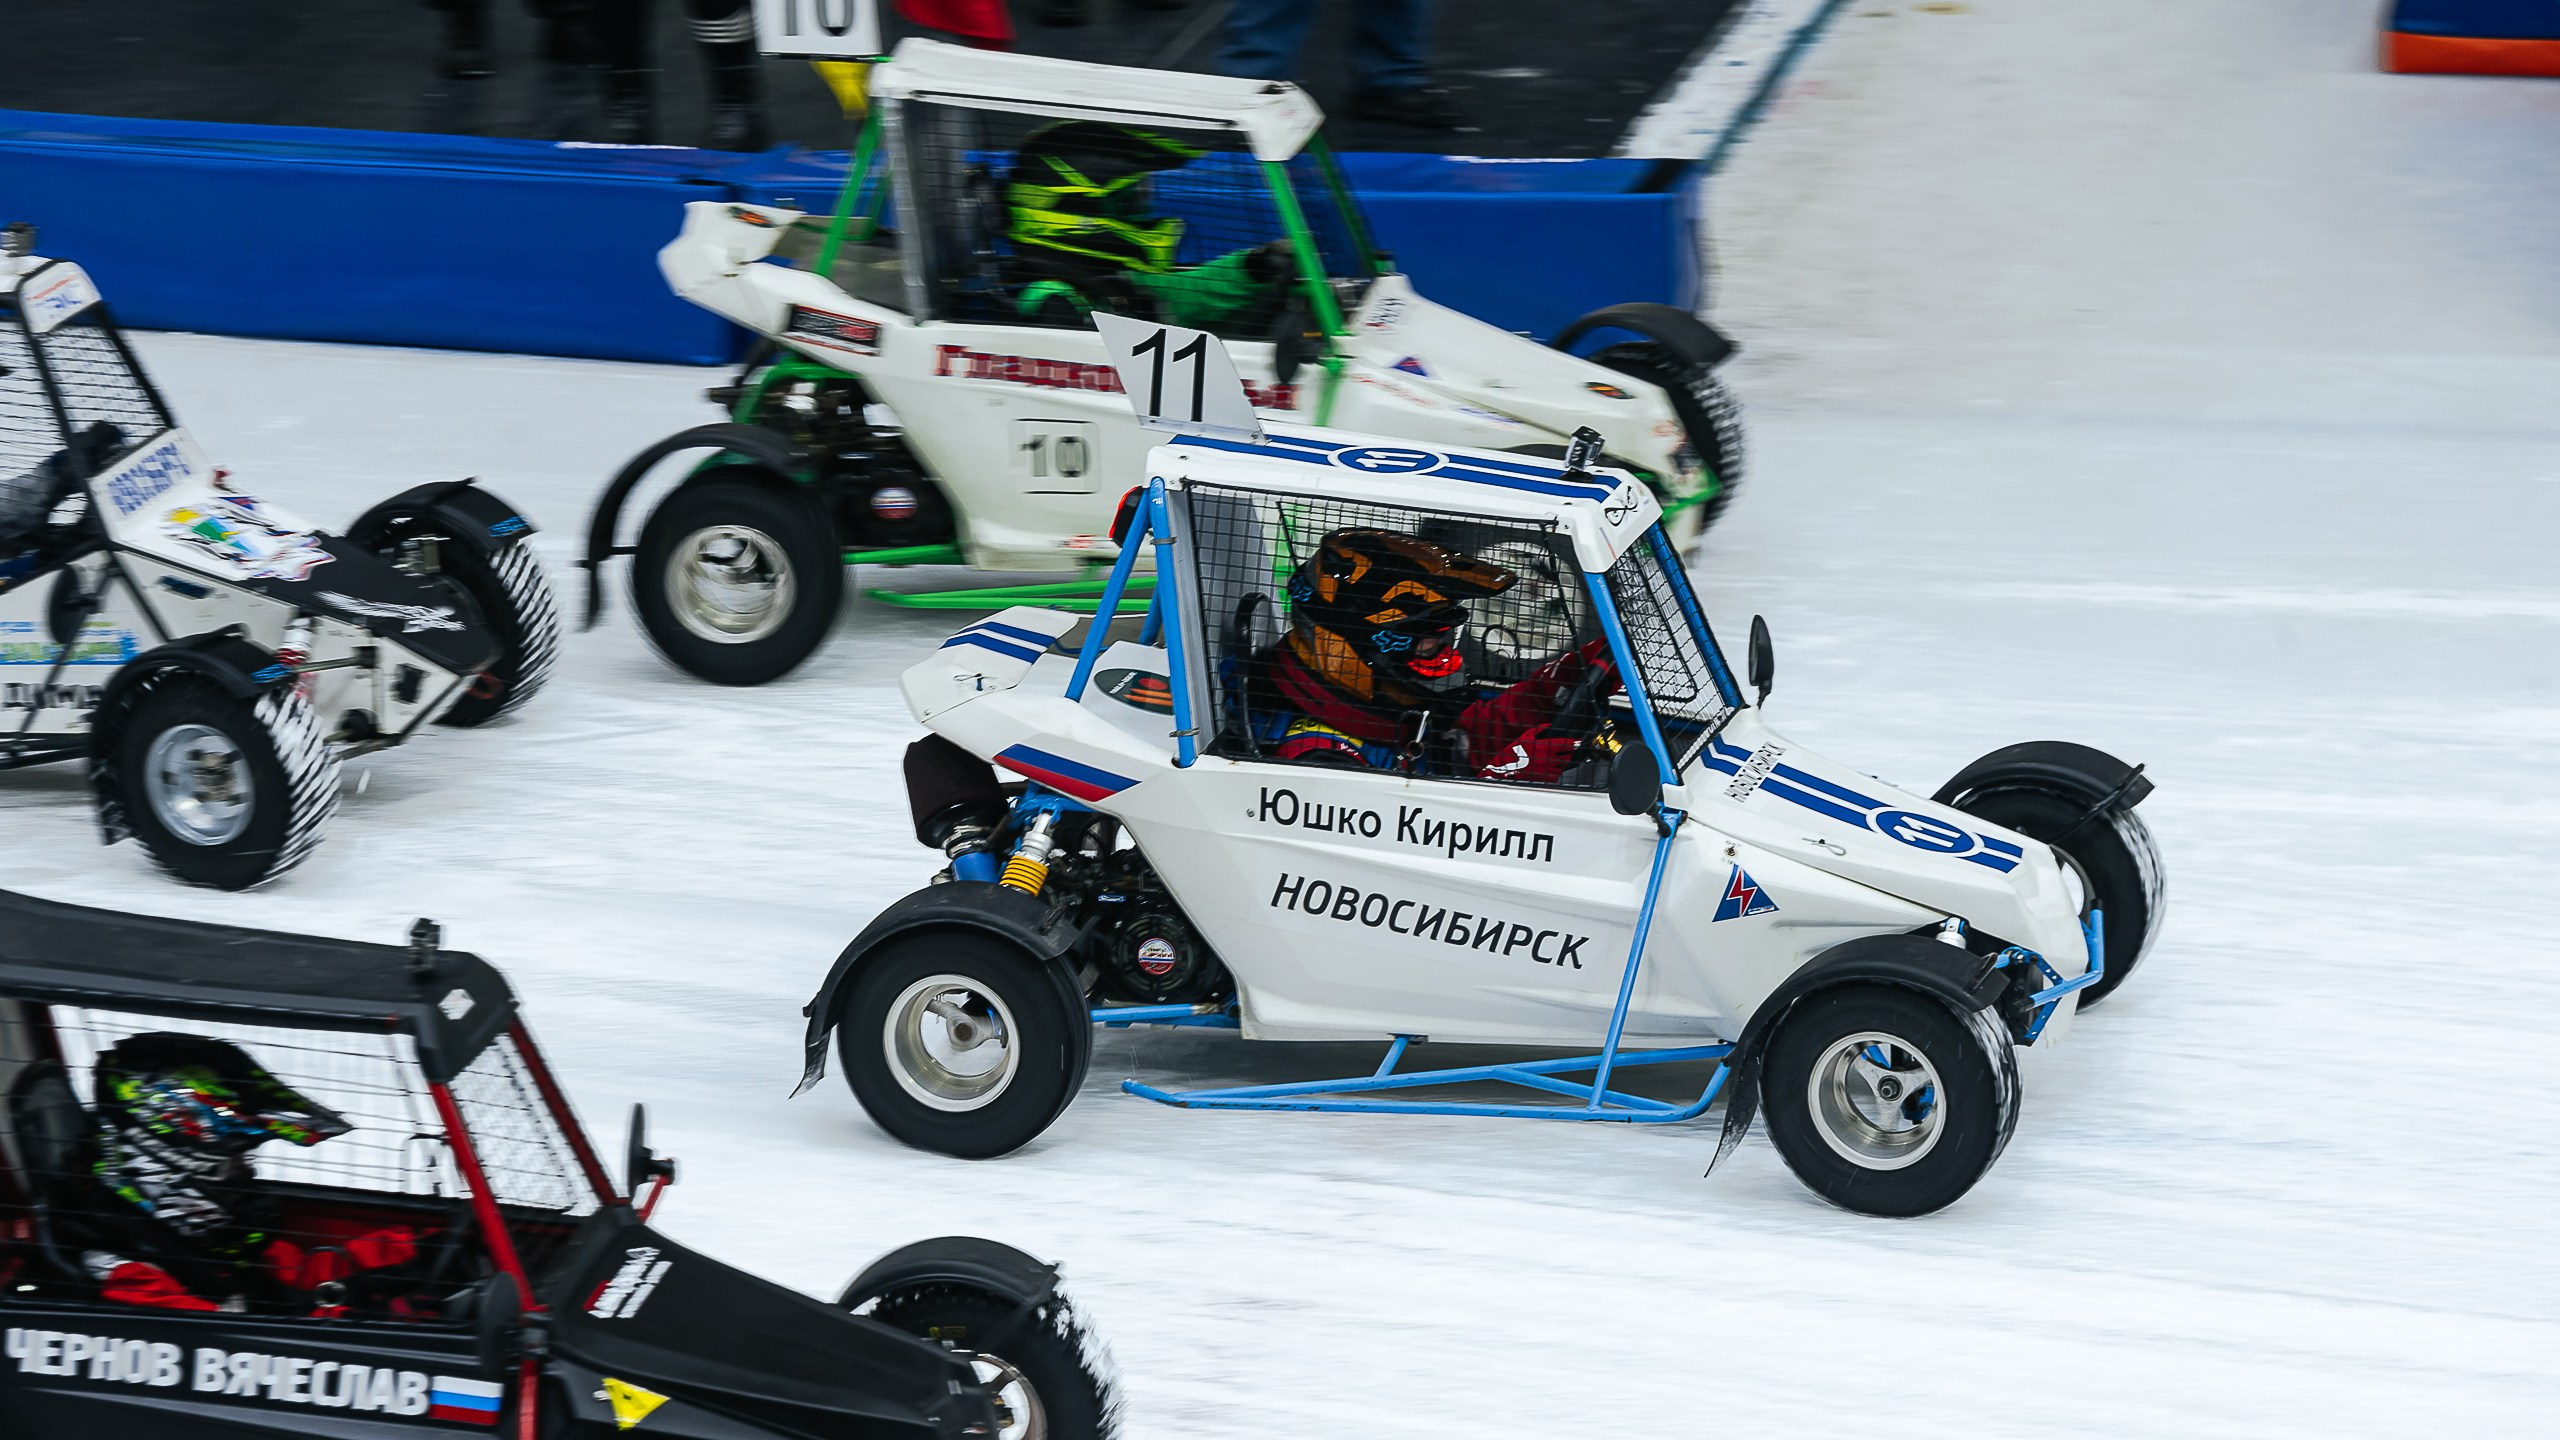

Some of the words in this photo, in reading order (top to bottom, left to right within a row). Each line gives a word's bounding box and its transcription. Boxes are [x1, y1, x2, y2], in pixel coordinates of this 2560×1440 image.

[1132, 328, 1207, 422] 11
[1018, 435, 1092, 478] 10
[1355, 450, 1427, 468] 11
[1259, 786, 1381, 839] Юшко
[1397, 805, 1554, 863] Кирилл
[1893, 815, 1962, 848] 11
[1271, 873, 1590, 970] НОВОСИБИРСК
[6, 1327, 182, 1388] ЧЕРНОВ
[192, 1347, 430, 1416] ВЯЧЕСЛАВ
